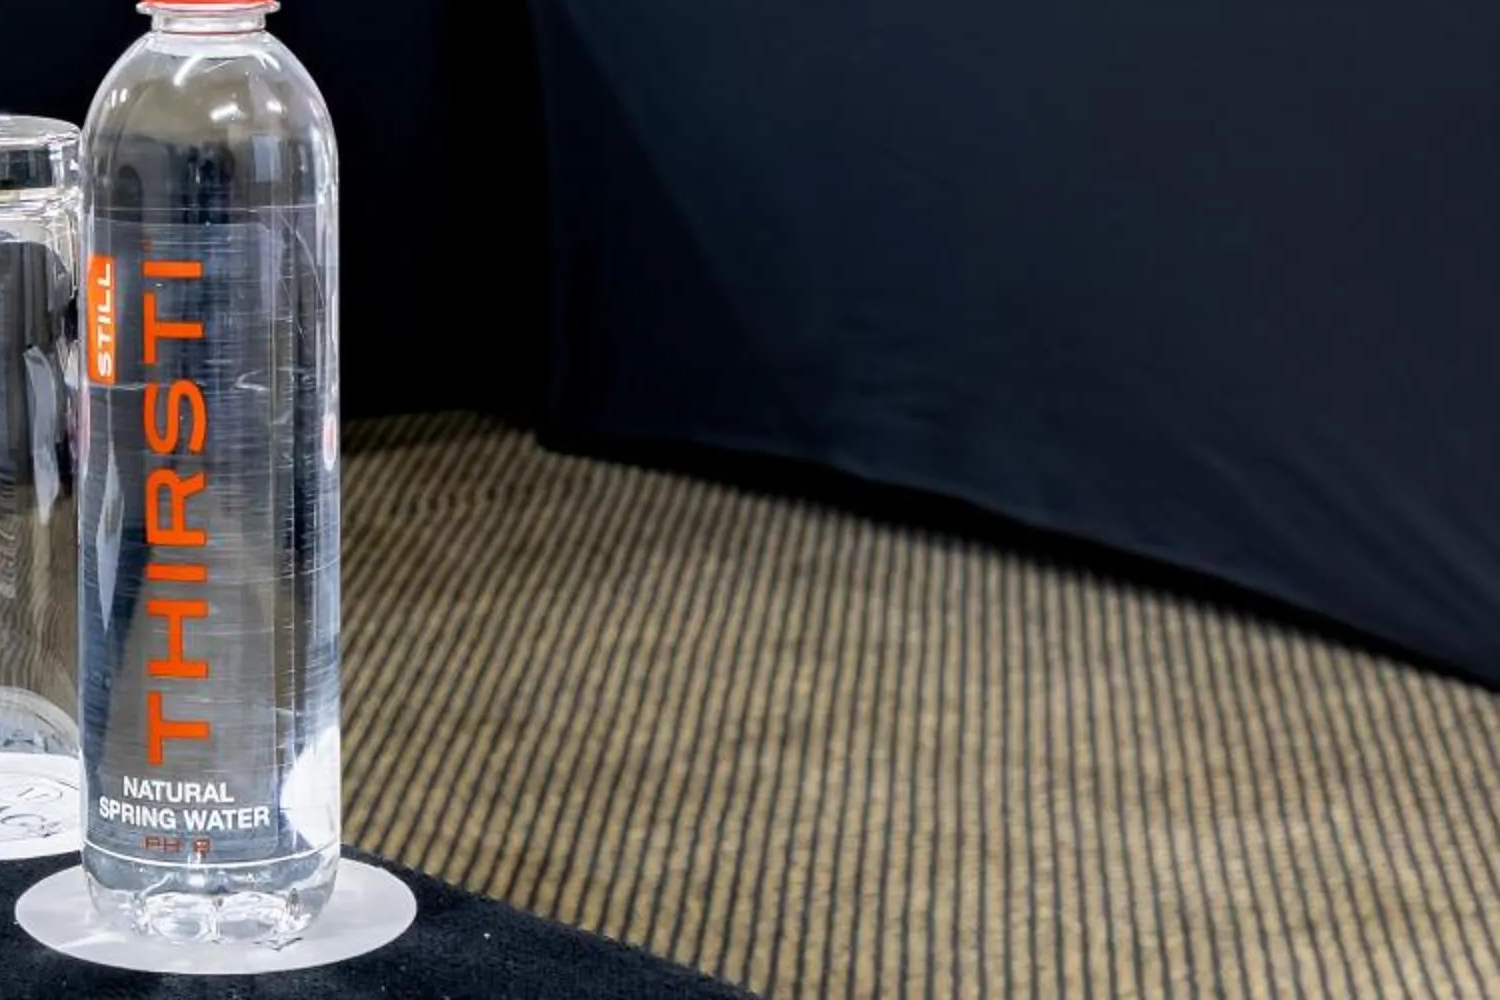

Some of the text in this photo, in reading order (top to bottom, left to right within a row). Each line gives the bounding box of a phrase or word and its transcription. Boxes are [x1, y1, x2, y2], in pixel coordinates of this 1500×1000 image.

[97, 262, 113, 378] STILL
[142, 259, 210, 766] THIRSTI
[99, 795, 272, 834] SPRING WATER
[123, 776, 235, 803] NATURAL
